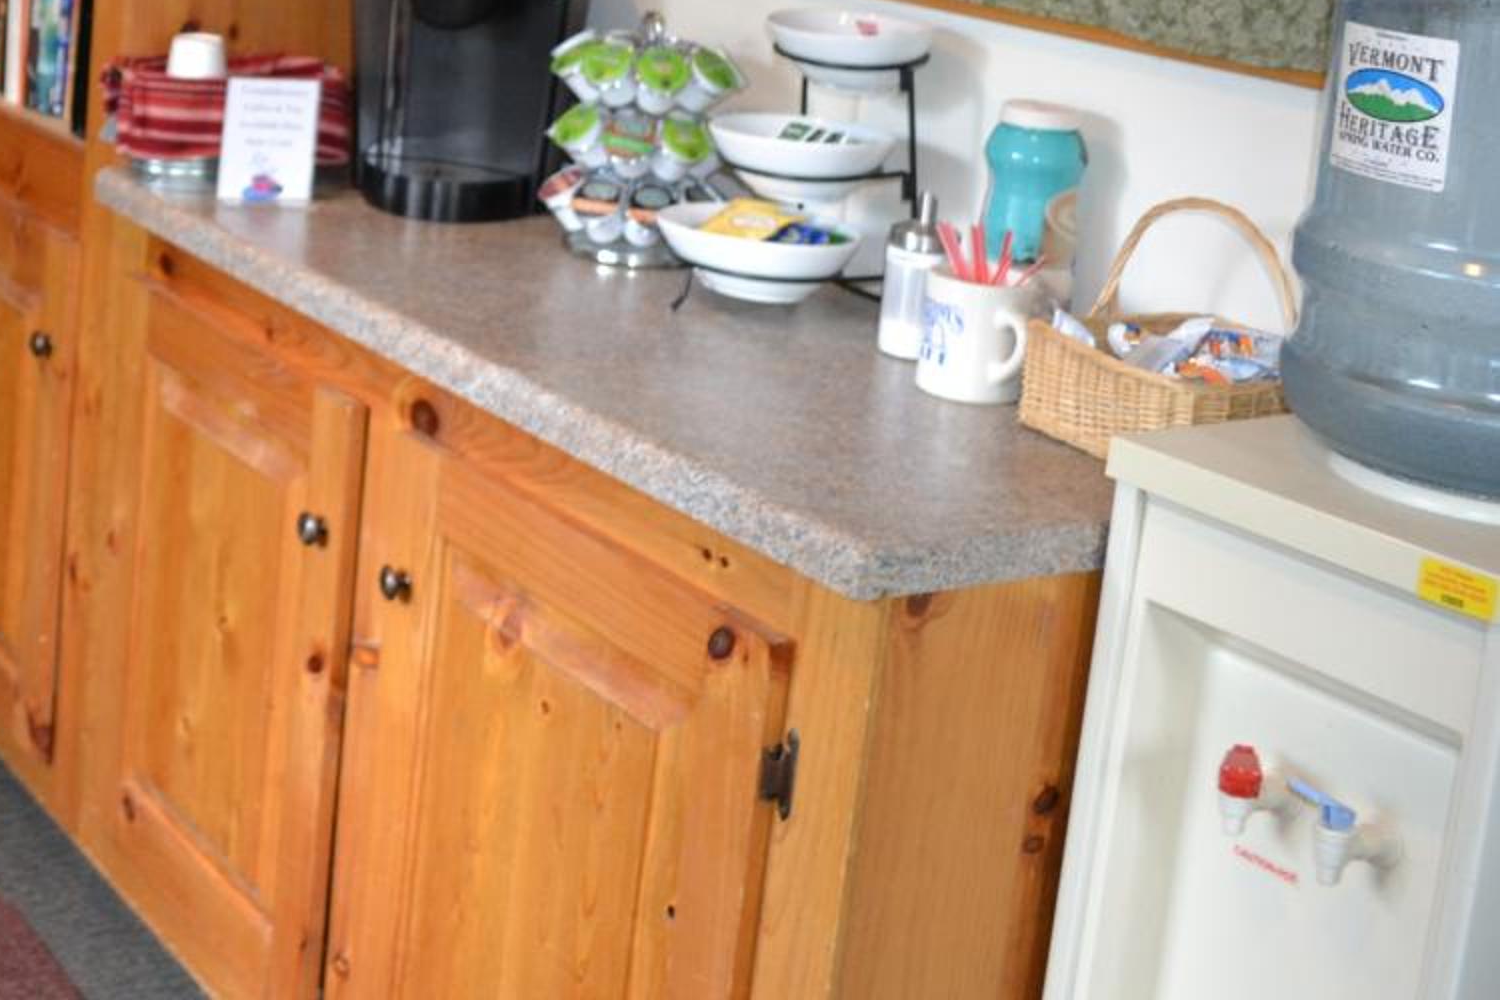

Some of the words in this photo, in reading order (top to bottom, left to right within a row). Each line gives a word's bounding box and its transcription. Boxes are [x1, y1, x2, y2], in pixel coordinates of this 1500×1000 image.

[1348, 41, 1445, 83] VERMONT
[1339, 100, 1441, 150] HERITAGE
[1371, 140, 1412, 158] WATER
[1416, 149, 1441, 164] CO.
